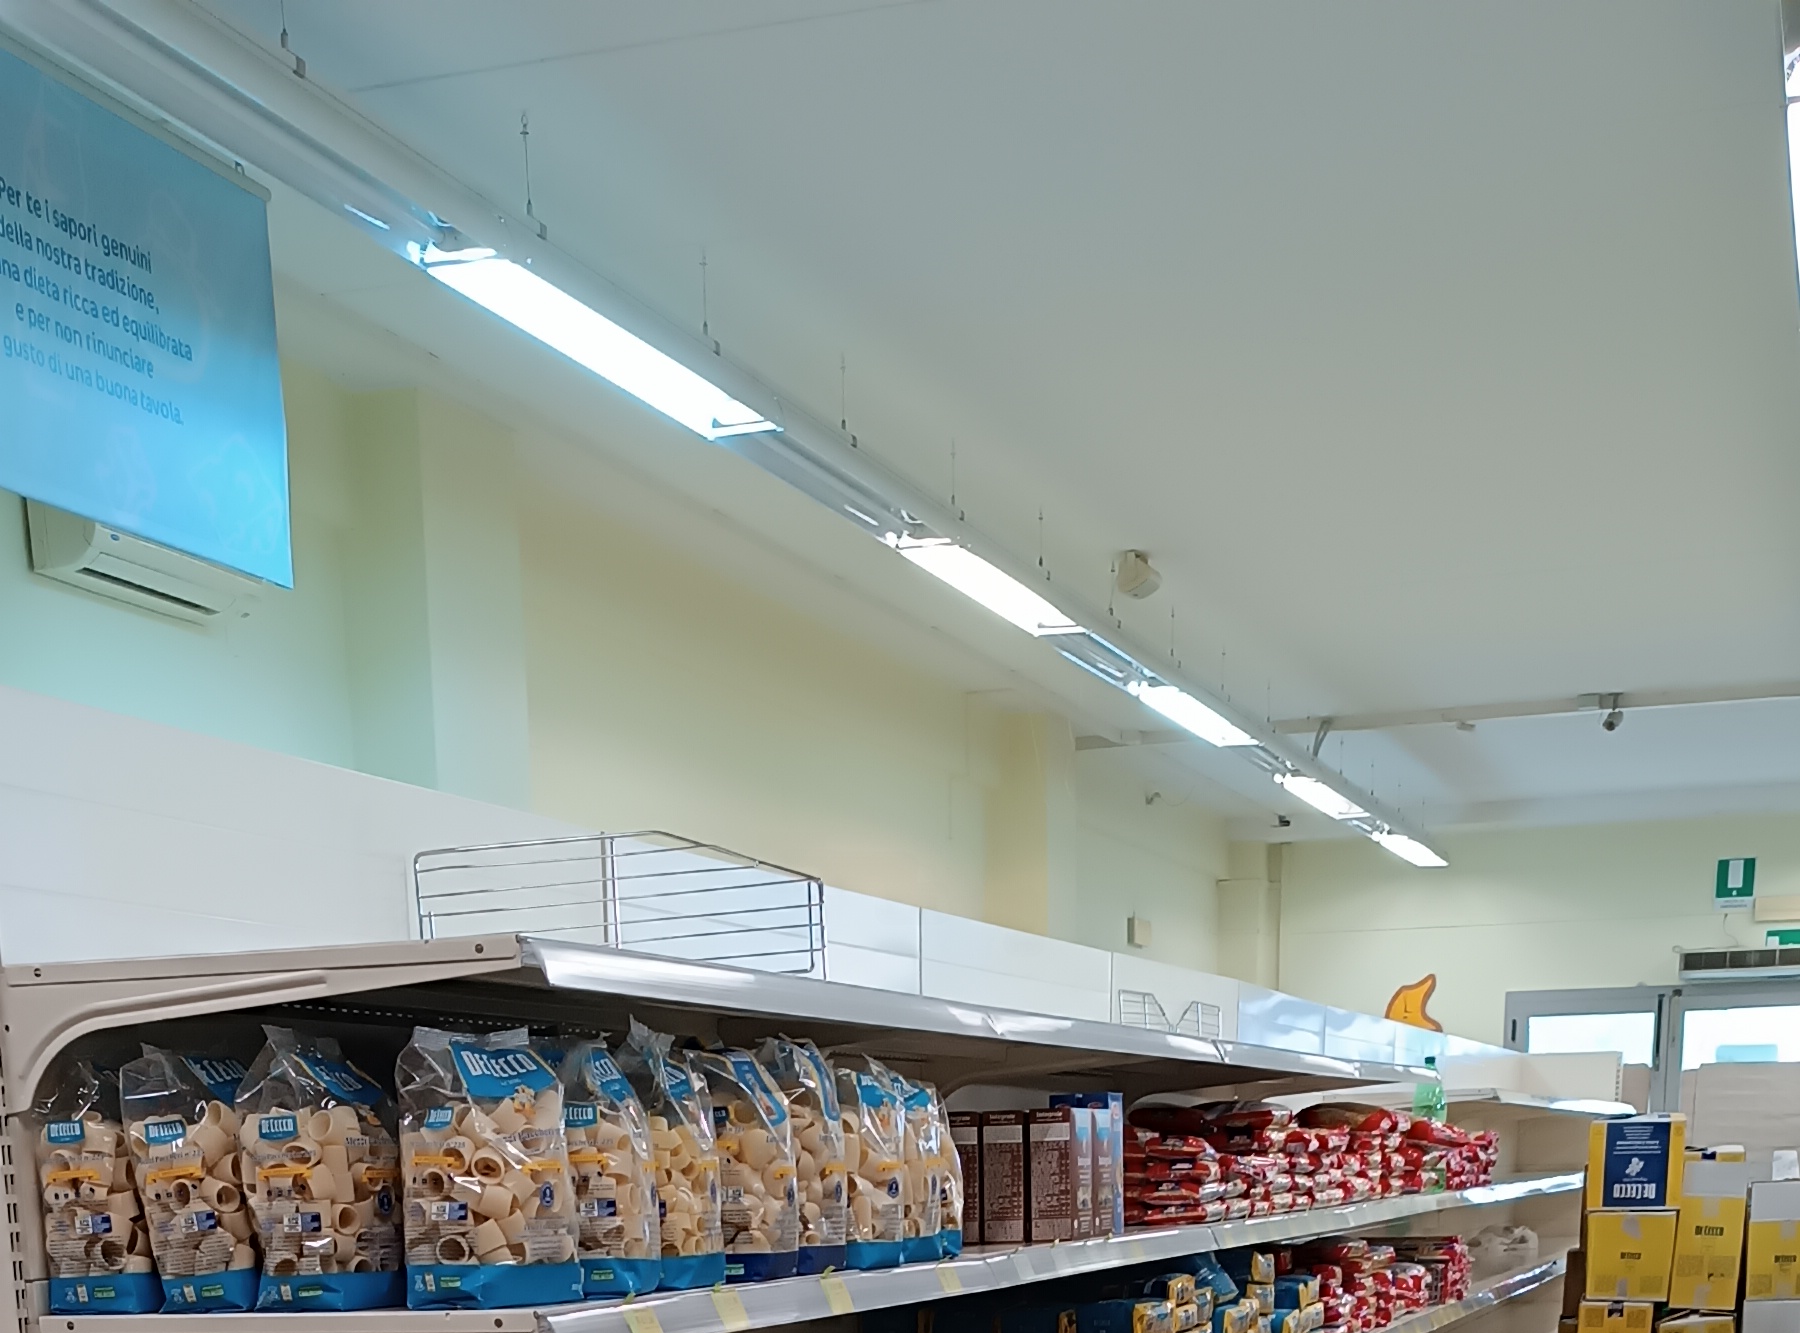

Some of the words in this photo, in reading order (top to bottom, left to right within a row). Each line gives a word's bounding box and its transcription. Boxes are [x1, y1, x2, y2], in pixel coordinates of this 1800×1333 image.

[26, 191, 42, 218] te
[45, 199, 51, 224] i
[53, 208, 98, 247] sapori
[101, 233, 152, 274] genuini
[24, 266, 60, 302] dieta
[63, 285, 98, 319] ricca
[102, 305, 120, 328] ed
[122, 318, 193, 362] equilibrata
[36, 237, 82, 276] nostra
[84, 258, 160, 315] tradizione,
[3, 335, 45, 368] gusto
[48, 354, 62, 376] di
[65, 360, 93, 388] una
[95, 369, 138, 407] buona
[140, 390, 184, 426] tavola.
[15, 301, 24, 322] e
[28, 307, 51, 332] per
[55, 321, 82, 349] non
[86, 332, 154, 379] rinunciare
